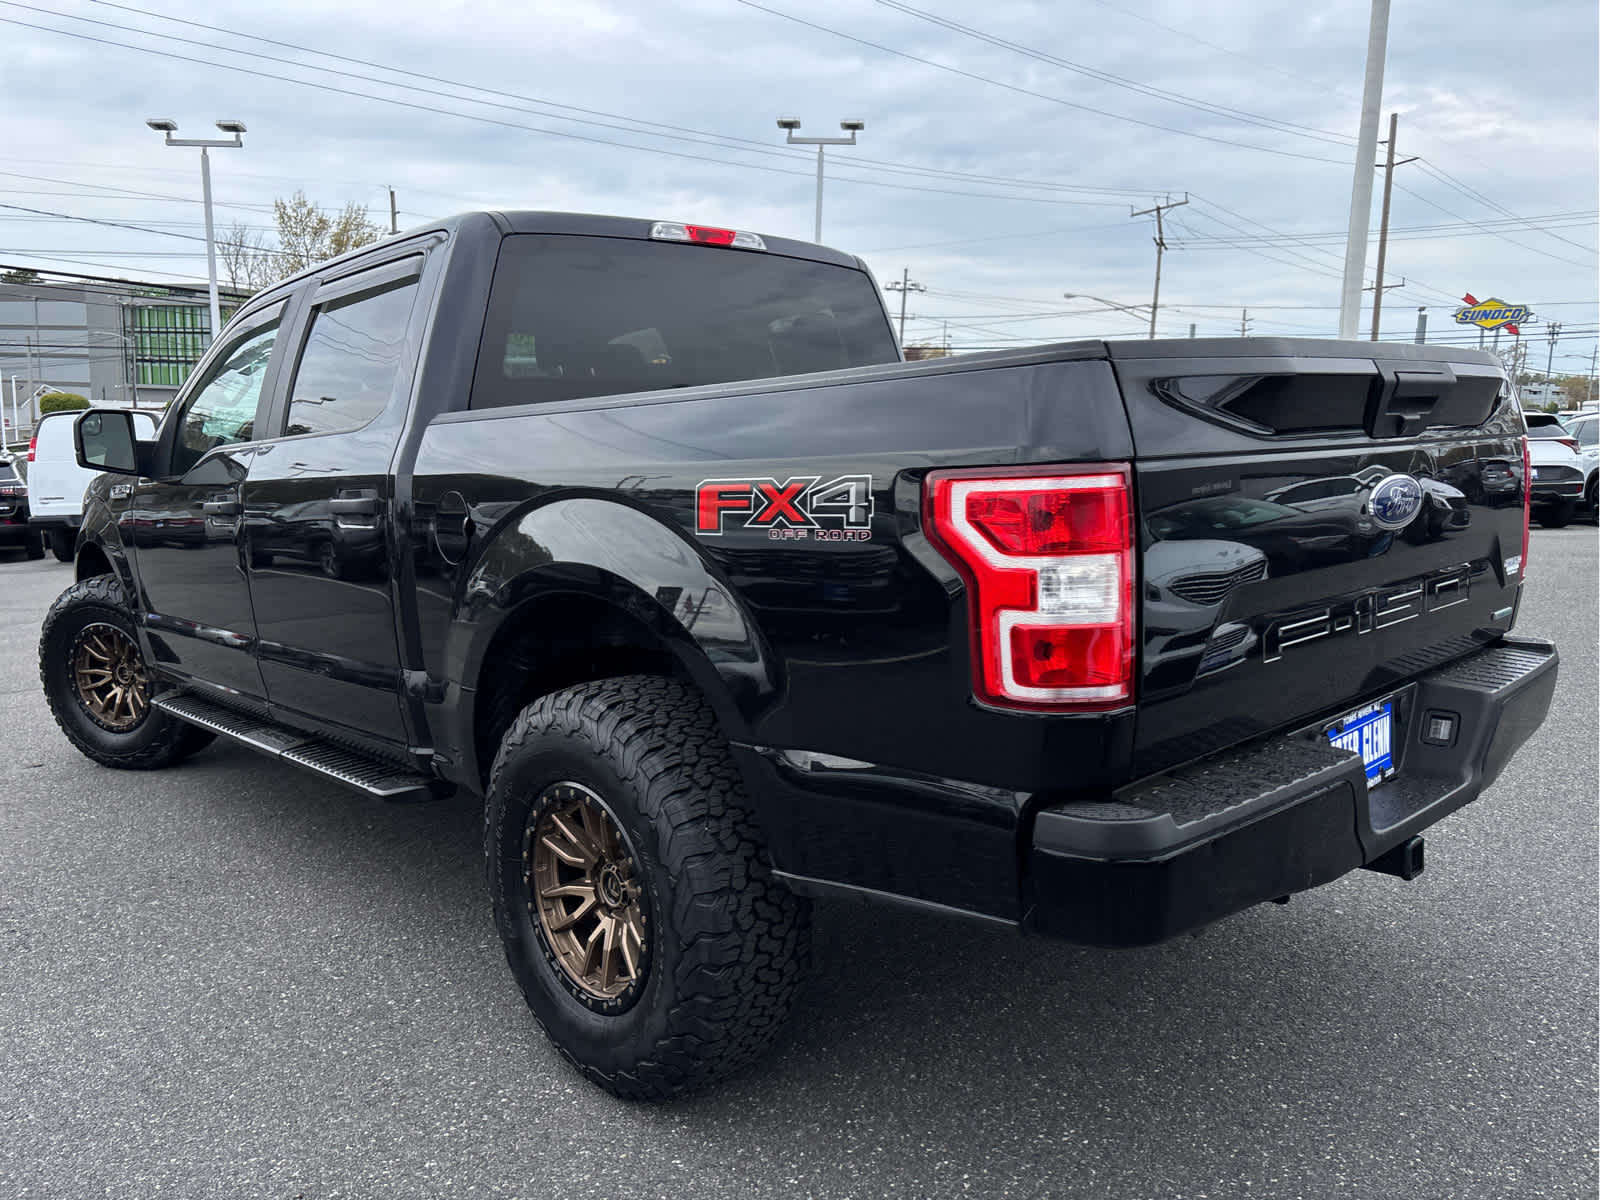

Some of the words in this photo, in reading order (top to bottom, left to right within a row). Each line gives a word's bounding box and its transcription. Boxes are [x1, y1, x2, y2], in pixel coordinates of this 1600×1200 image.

[1459, 308, 1523, 321] SUNOCO
[696, 475, 874, 535] FX4
[768, 529, 808, 540] OFF
[815, 530, 872, 541] ROAD
[1264, 562, 1471, 664] F-150
[1362, 715, 1390, 765] GLENN
